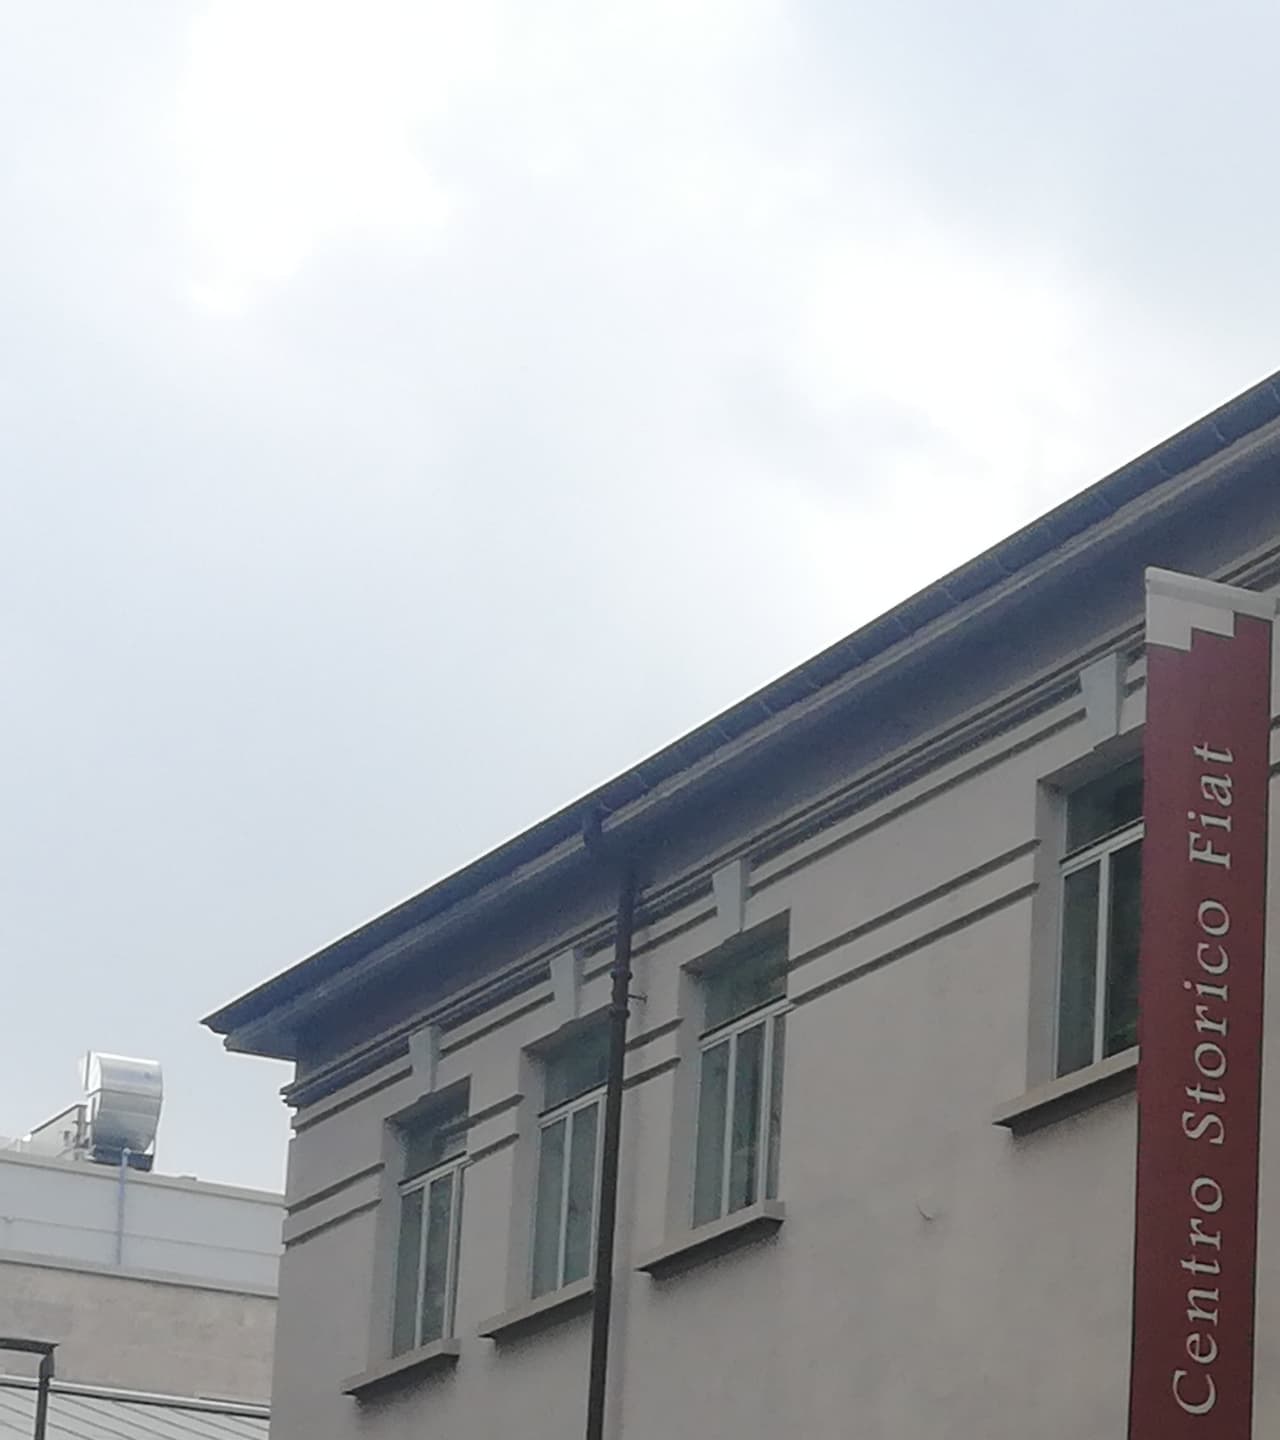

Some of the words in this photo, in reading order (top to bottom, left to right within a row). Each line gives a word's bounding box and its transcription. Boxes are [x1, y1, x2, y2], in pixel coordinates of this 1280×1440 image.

[1188, 741, 1236, 871] Fiat
[1182, 898, 1231, 1146] Storico
[1173, 1176, 1225, 1417] Centro
